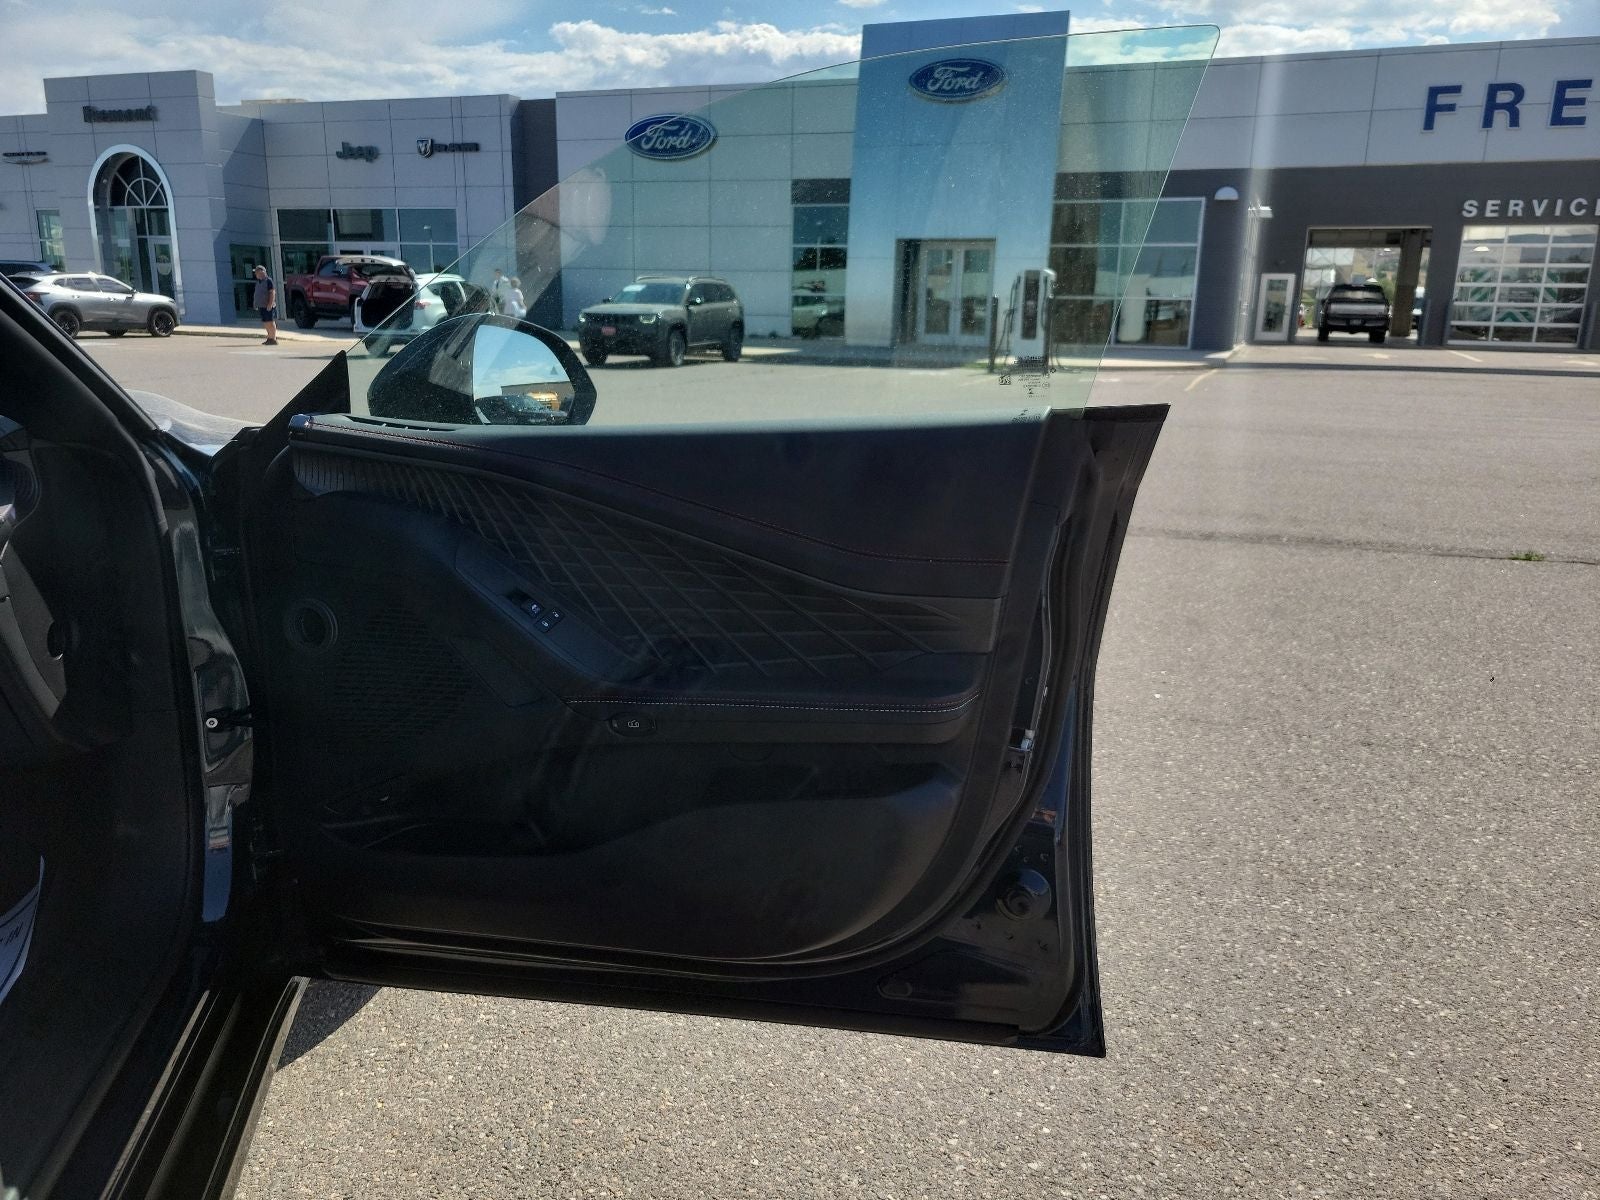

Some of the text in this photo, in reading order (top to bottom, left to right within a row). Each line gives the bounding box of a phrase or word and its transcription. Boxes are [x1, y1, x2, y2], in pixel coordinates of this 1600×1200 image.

[926, 66, 984, 91] Ford
[1422, 78, 1594, 132] FRE
[641, 124, 693, 150] Ford
[336, 141, 379, 162] Jeep
